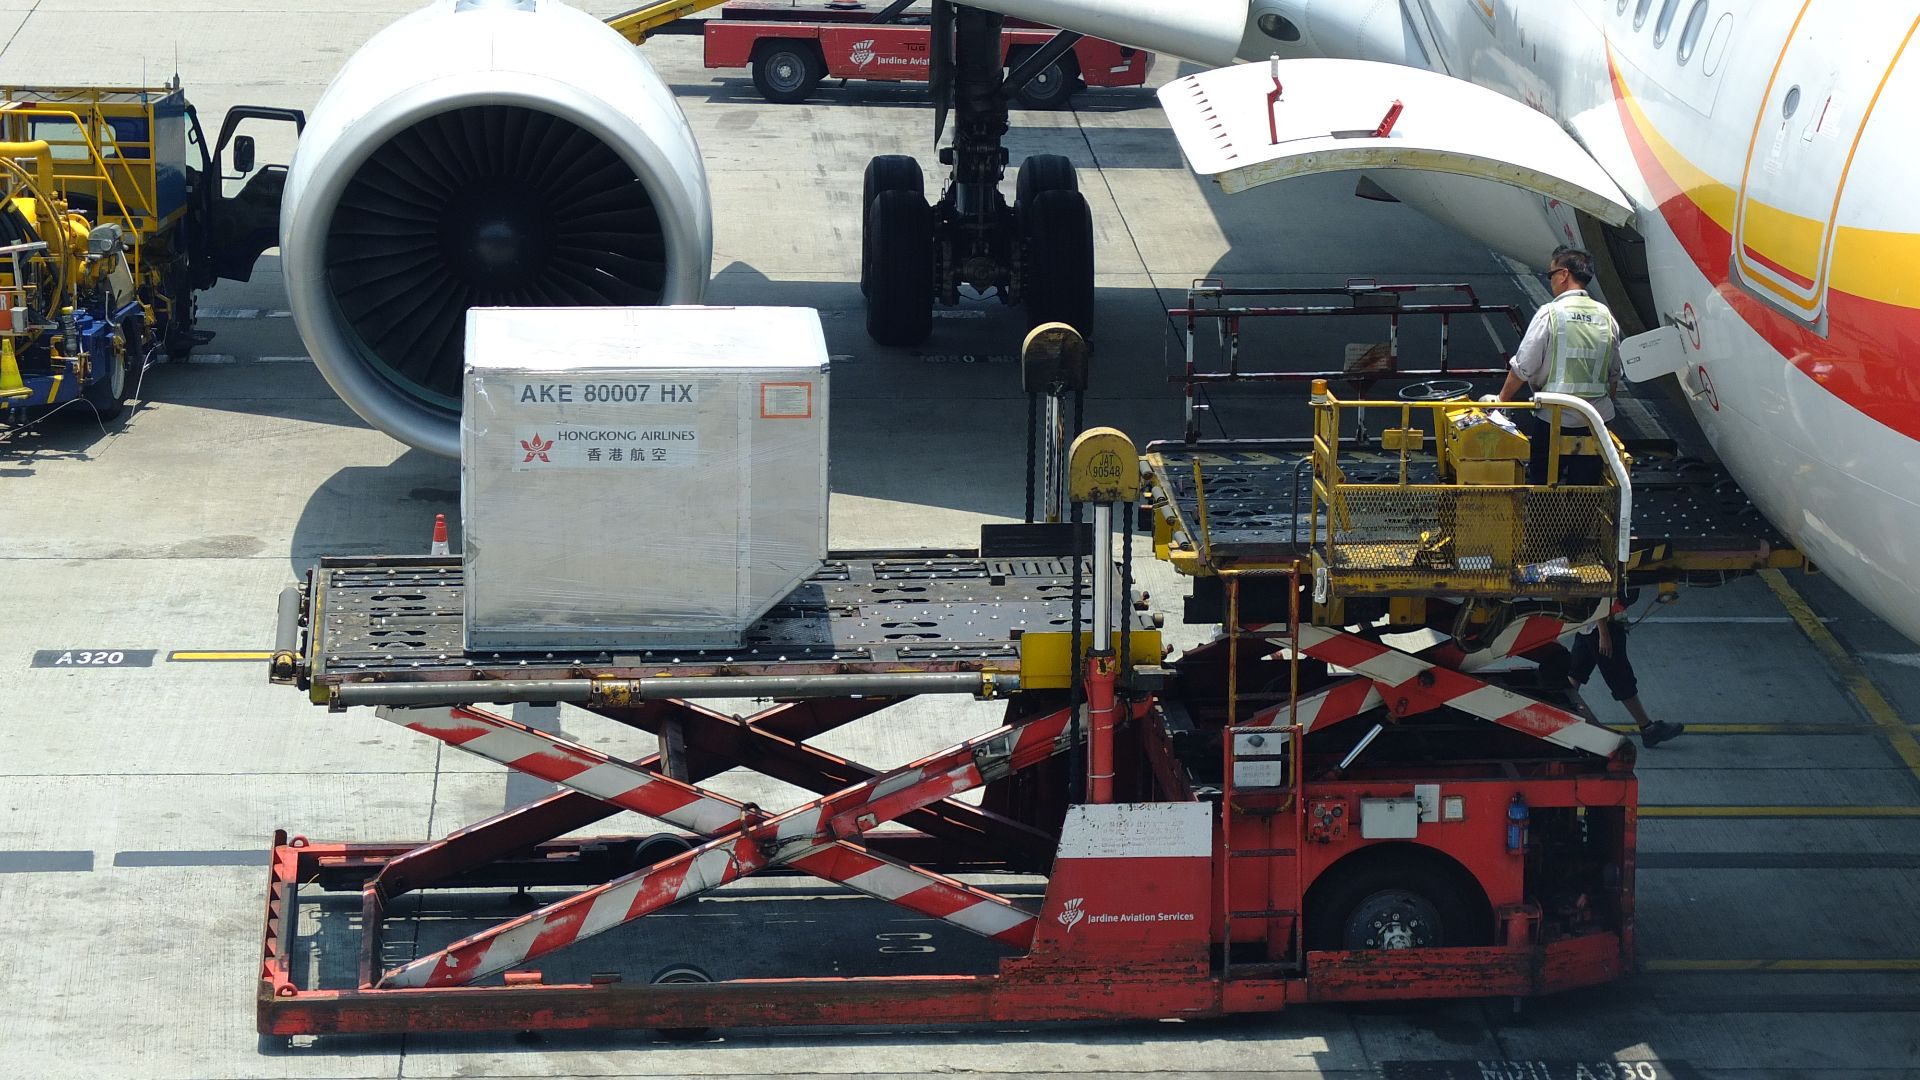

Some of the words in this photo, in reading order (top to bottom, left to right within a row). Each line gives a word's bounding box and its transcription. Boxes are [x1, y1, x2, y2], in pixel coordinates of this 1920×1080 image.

[877, 56, 907, 65] Jardine
[1571, 312, 1592, 322] JATS
[520, 385, 573, 403] AKE
[583, 385, 651, 403] 80007
[660, 384, 693, 403] HX
[558, 431, 637, 441] HONGKONG
[640, 431, 695, 441] AIRLINES
[587, 448, 667, 461] 香港航空
[1099, 454, 1114, 466] JAT
[1093, 466, 1121, 477] 90548
[55, 651, 124, 665] A320
[1088, 914, 1118, 924] Jardine
[1120, 913, 1155, 922] Aviation
[1158, 912, 1194, 921] Services
[1575, 1060, 1657, 1080] A330
